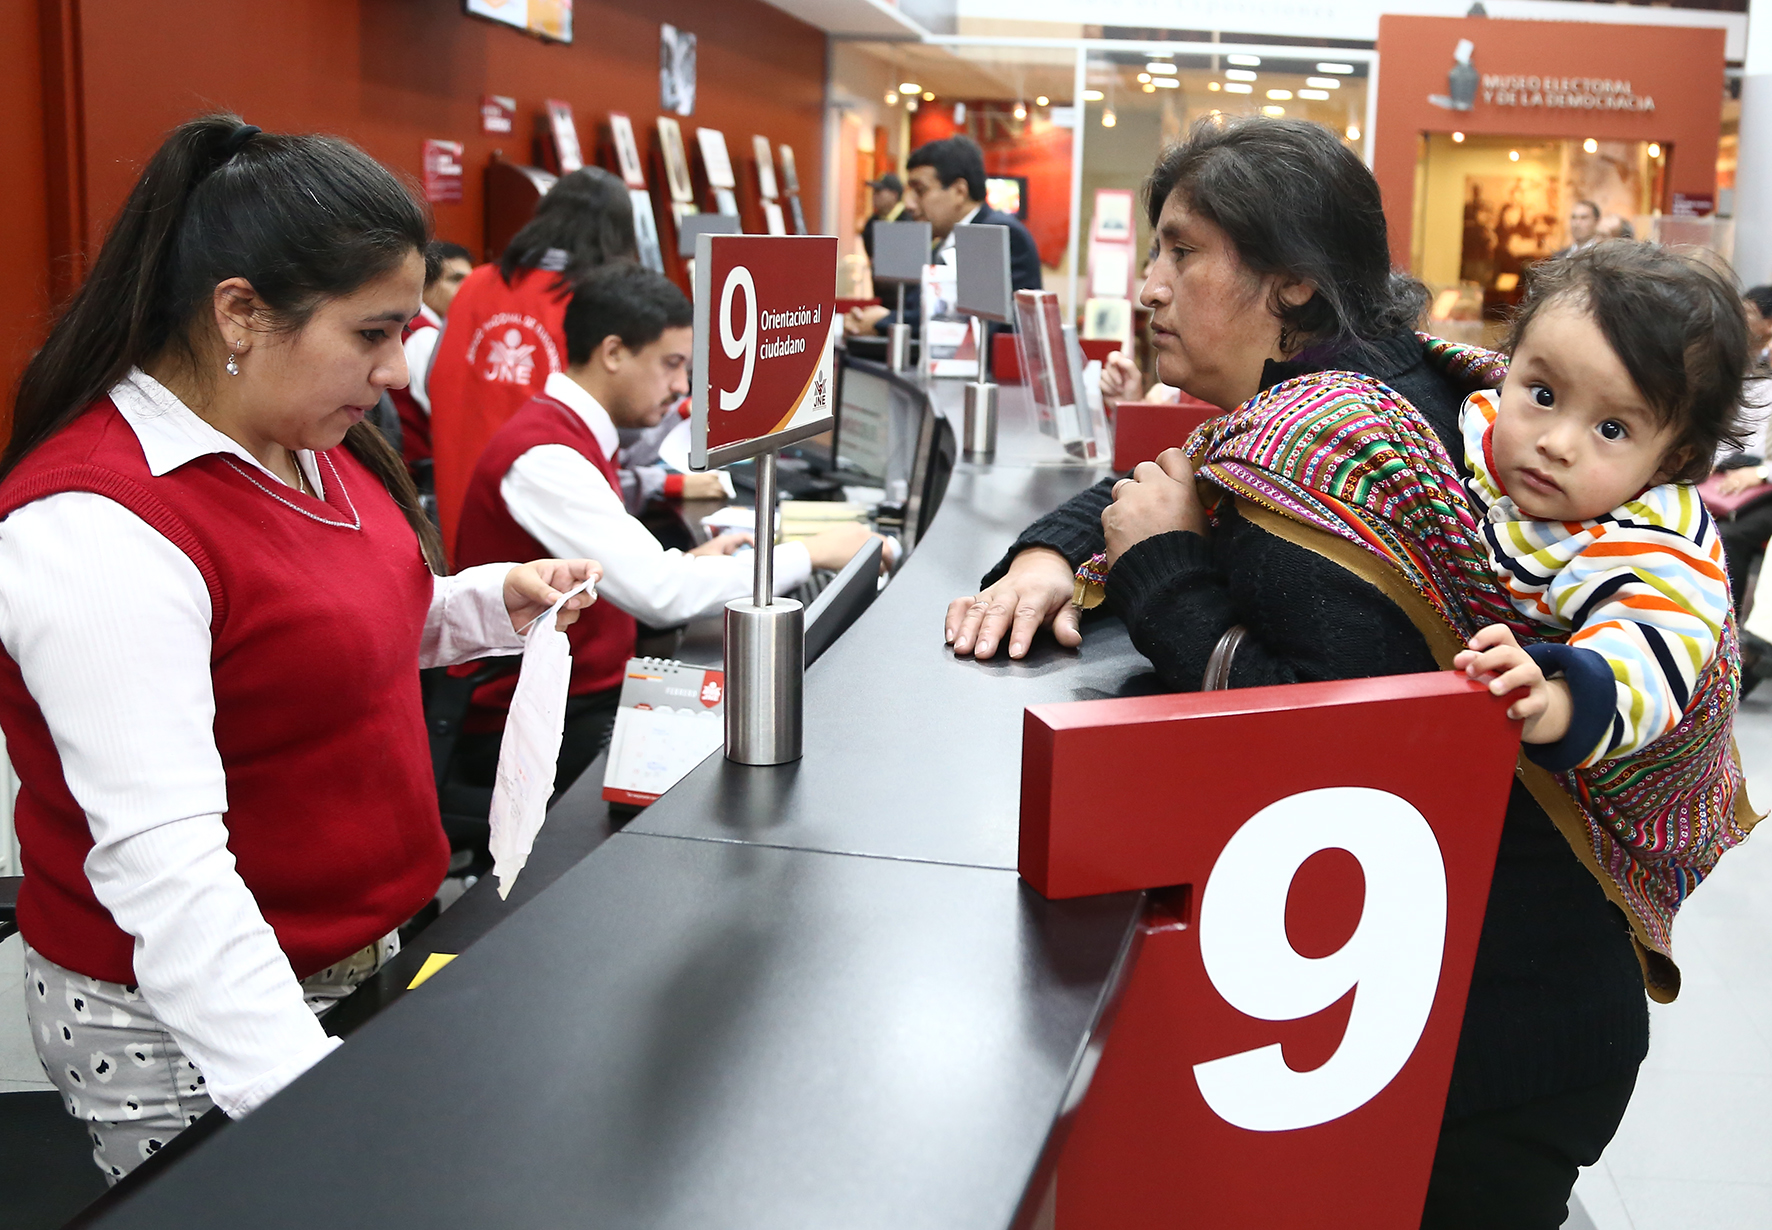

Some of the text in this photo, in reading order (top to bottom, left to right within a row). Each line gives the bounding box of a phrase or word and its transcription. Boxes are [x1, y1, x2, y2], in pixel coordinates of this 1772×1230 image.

[1482, 74, 1631, 95] MUSEO ELECTORAL
[1483, 90, 1655, 111] Y DE LA DEMOCRACIA
[761, 303, 821, 331] Orientación al
[719, 265, 758, 412] 9
[760, 334, 806, 360] ciudadano
[484, 363, 531, 385] JNE
[813, 394, 826, 407] JNE
[1192, 786, 1448, 1132] 9
